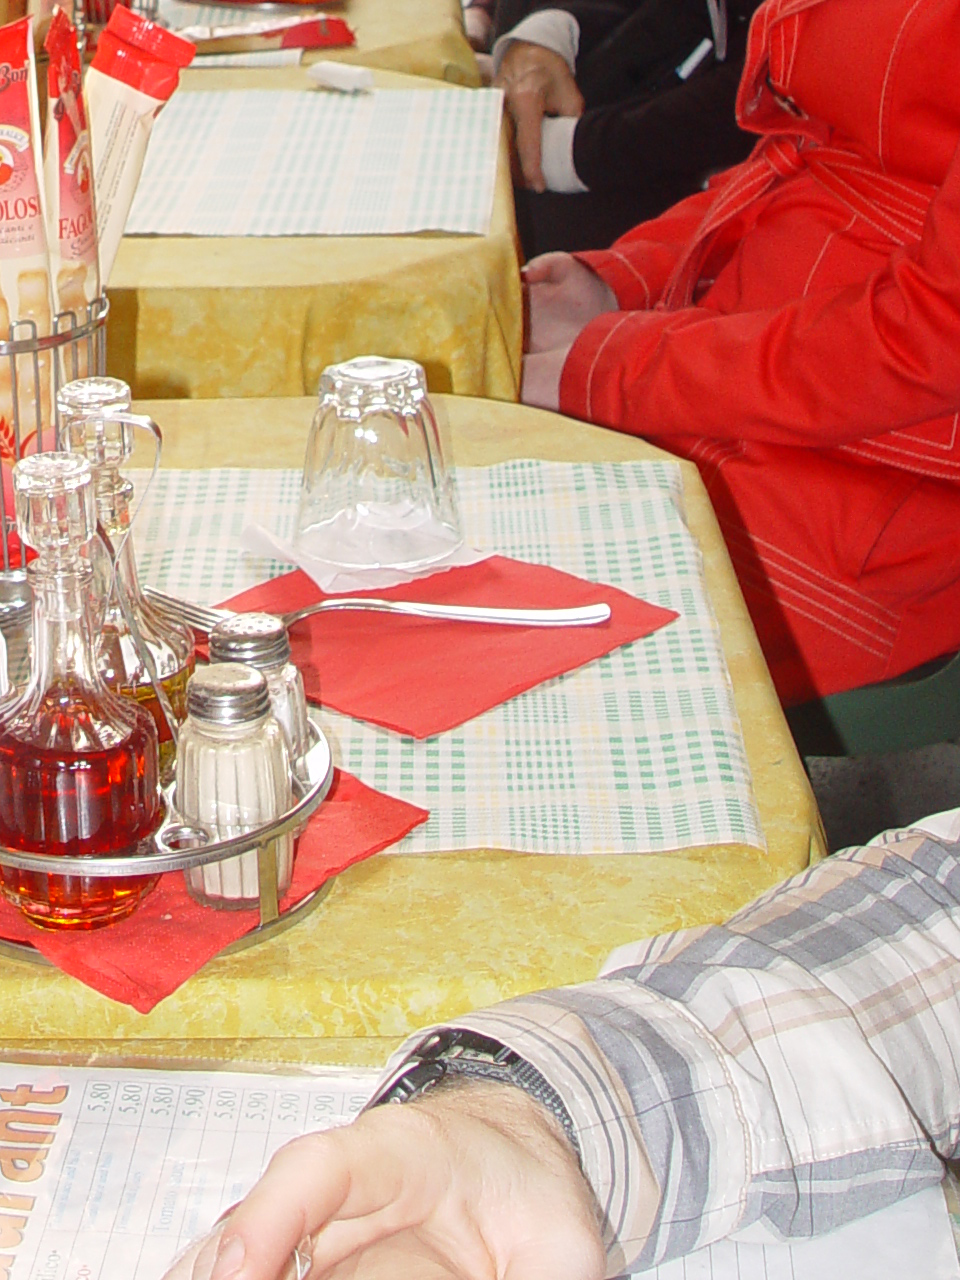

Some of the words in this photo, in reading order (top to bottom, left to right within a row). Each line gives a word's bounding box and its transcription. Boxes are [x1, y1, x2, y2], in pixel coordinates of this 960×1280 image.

[87, 1083, 111, 1112] 5,80
[118, 1084, 143, 1114] 5,80
[150, 1087, 174, 1116] 5,80
[182, 1089, 206, 1118] 5,90
[214, 1090, 237, 1119] 5,80
[245, 1092, 268, 1121] 5,90
[277, 1093, 300, 1122] 5,90
[312, 1095, 335, 1123] 5,90
[152, 1191, 177, 1232] Tomato
